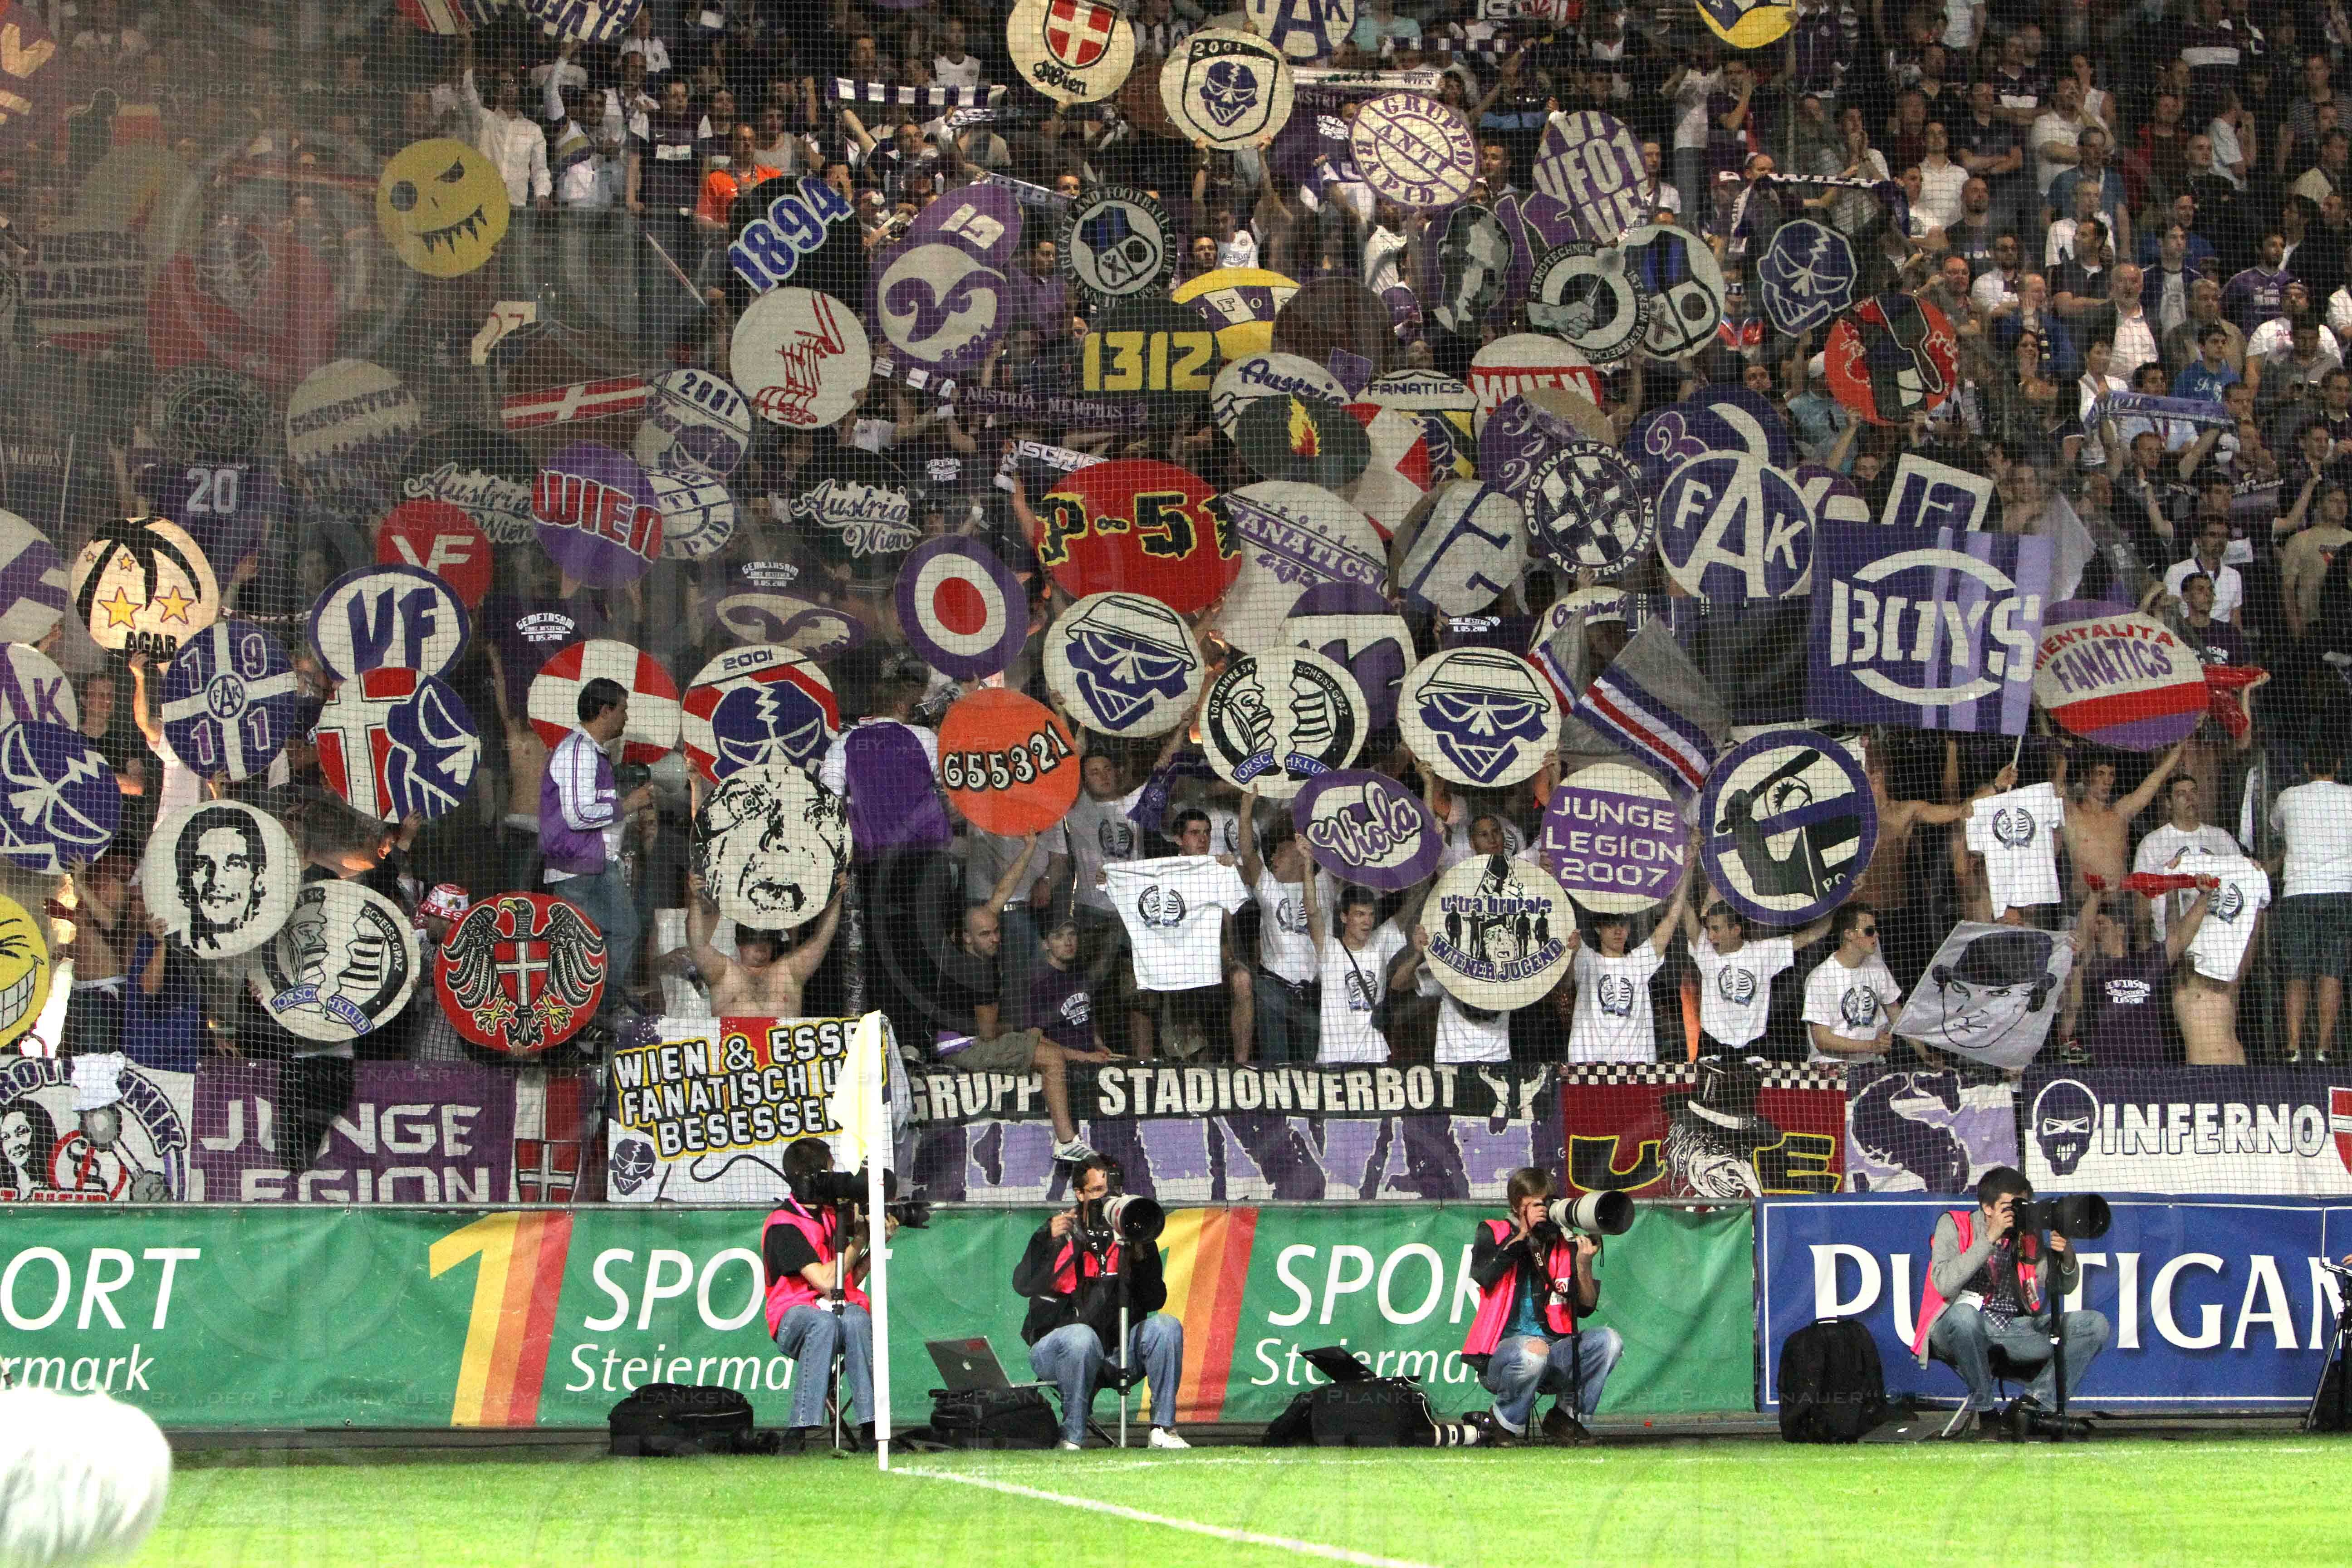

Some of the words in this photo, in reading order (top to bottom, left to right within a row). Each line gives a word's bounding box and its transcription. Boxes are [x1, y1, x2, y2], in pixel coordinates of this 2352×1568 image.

[1192, 41, 1242, 56] 2001
[1382, 95, 1475, 166] GRUPPO
[1355, 139, 1435, 204] RAPID
[727, 176, 855, 294] 1894
[1083, 331, 1214, 391] 1312
[679, 372, 739, 417] 2001
[1368, 382, 1465, 397] FANATICS
[186, 467, 239, 515] 20
[789, 478, 921, 536] Austria
[843, 523, 914, 558] Wien
[1548, 552, 1637, 579] AURIA
[125, 631, 177, 661] ACAB
[347, 586, 439, 674] VF
[516, 612, 575, 630] GEMEINSAM
[1830, 578, 2040, 683] BOYS
[722, 648, 773, 670] 2001
[2051, 636, 2174, 694] FANATICS
[1210, 700, 1220, 719] 100
[1217, 668, 1240, 699] JAHRE
[1242, 663, 1255, 673] SK
[1297, 665, 1334, 691] SCHEISS
[1331, 689, 1348, 716] GRAZ
[1307, 779, 1423, 868] Viola
[1553, 795, 1676, 834] JUNGE
[1546, 827, 1684, 866] LEGION
[1560, 857, 1671, 888] 2007
[1441, 895, 1483, 912] ultra
[1487, 895, 1553, 915] brutale
[364, 907, 397, 941] SCHEISS
[392, 942, 404, 972] GRAZ
[1498, 937, 1564, 982] JUGEND
[615, 1044, 712, 1090] WIEN
[726, 1034, 757, 1073] &
[770, 1021, 858, 1066] ESSE
[622, 1064, 801, 1128] FANATISCH
[908, 1069, 1047, 1122] GRUPP
[1098, 1063, 1458, 1116] STADIONVERBOT
[2101, 1102, 2327, 1158] INFERNO
[583, 1245, 767, 1332] SPO
[1808, 1243, 2345, 1352] PUTIGA
[565, 1342, 795, 1392] Steierma
